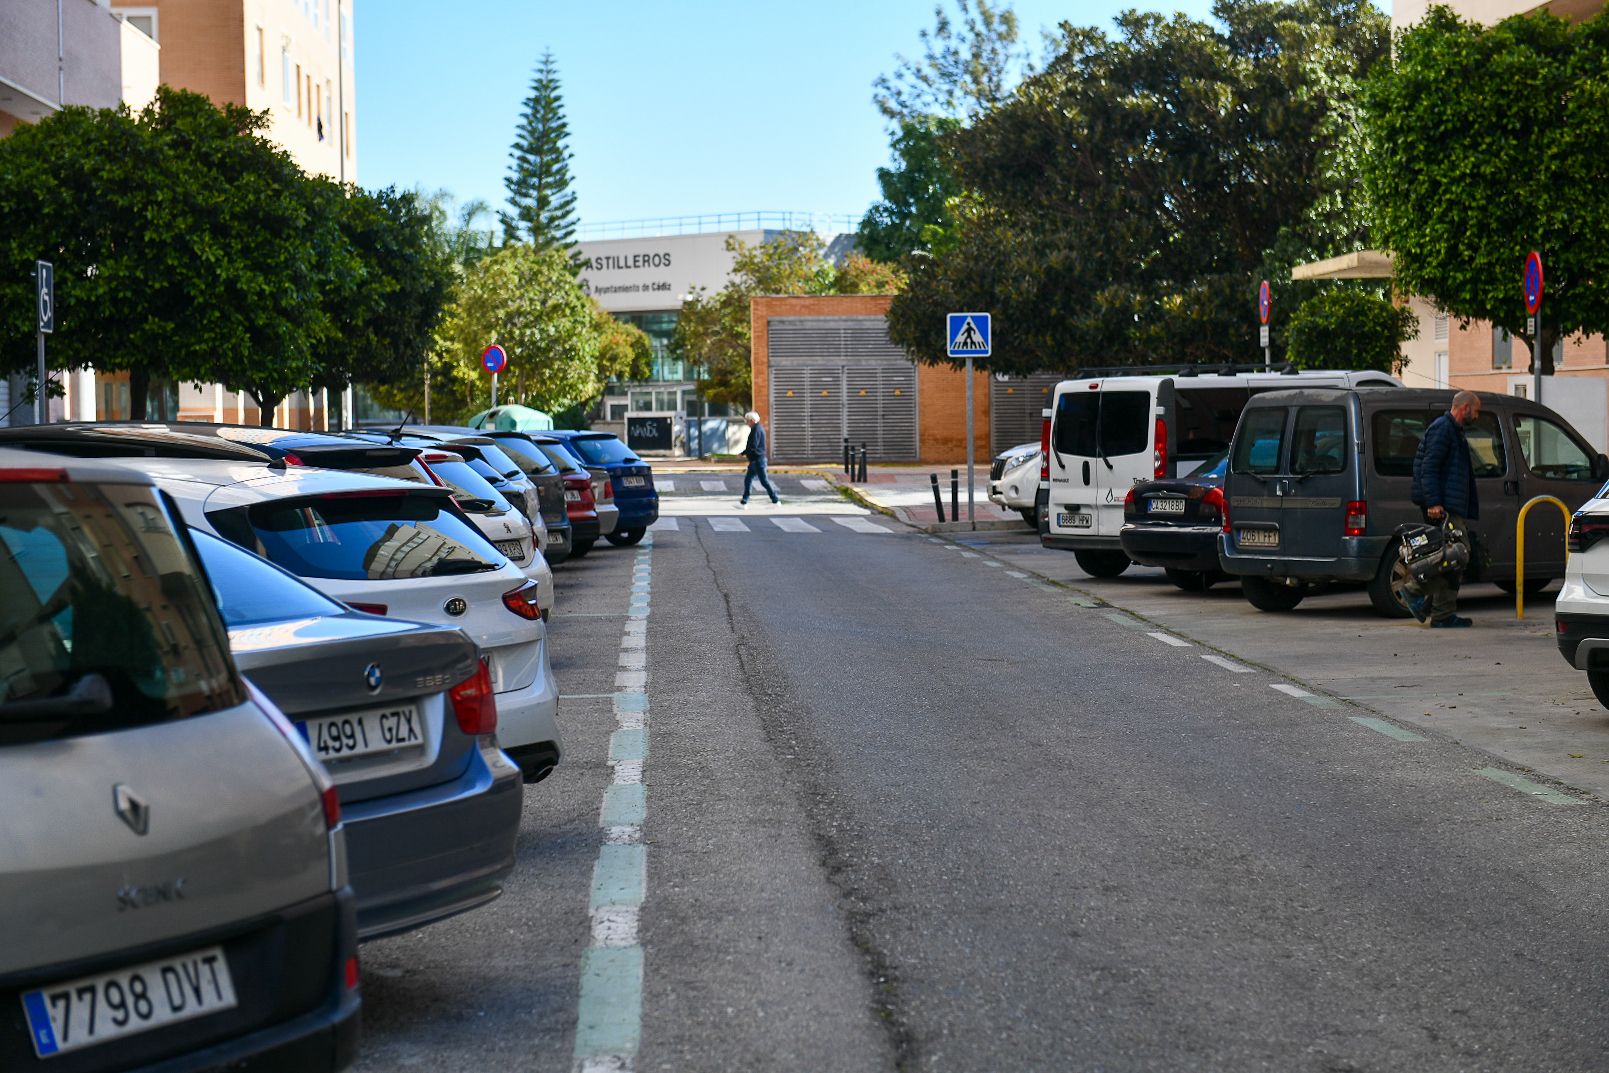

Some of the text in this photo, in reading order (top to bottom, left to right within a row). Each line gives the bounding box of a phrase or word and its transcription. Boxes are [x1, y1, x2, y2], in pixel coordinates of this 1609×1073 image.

[594, 281, 672, 296] Ayuntamiento de Cádiz
[316, 708, 419, 756] 4991 GZX
[50, 954, 224, 1044] 7798 DVT
